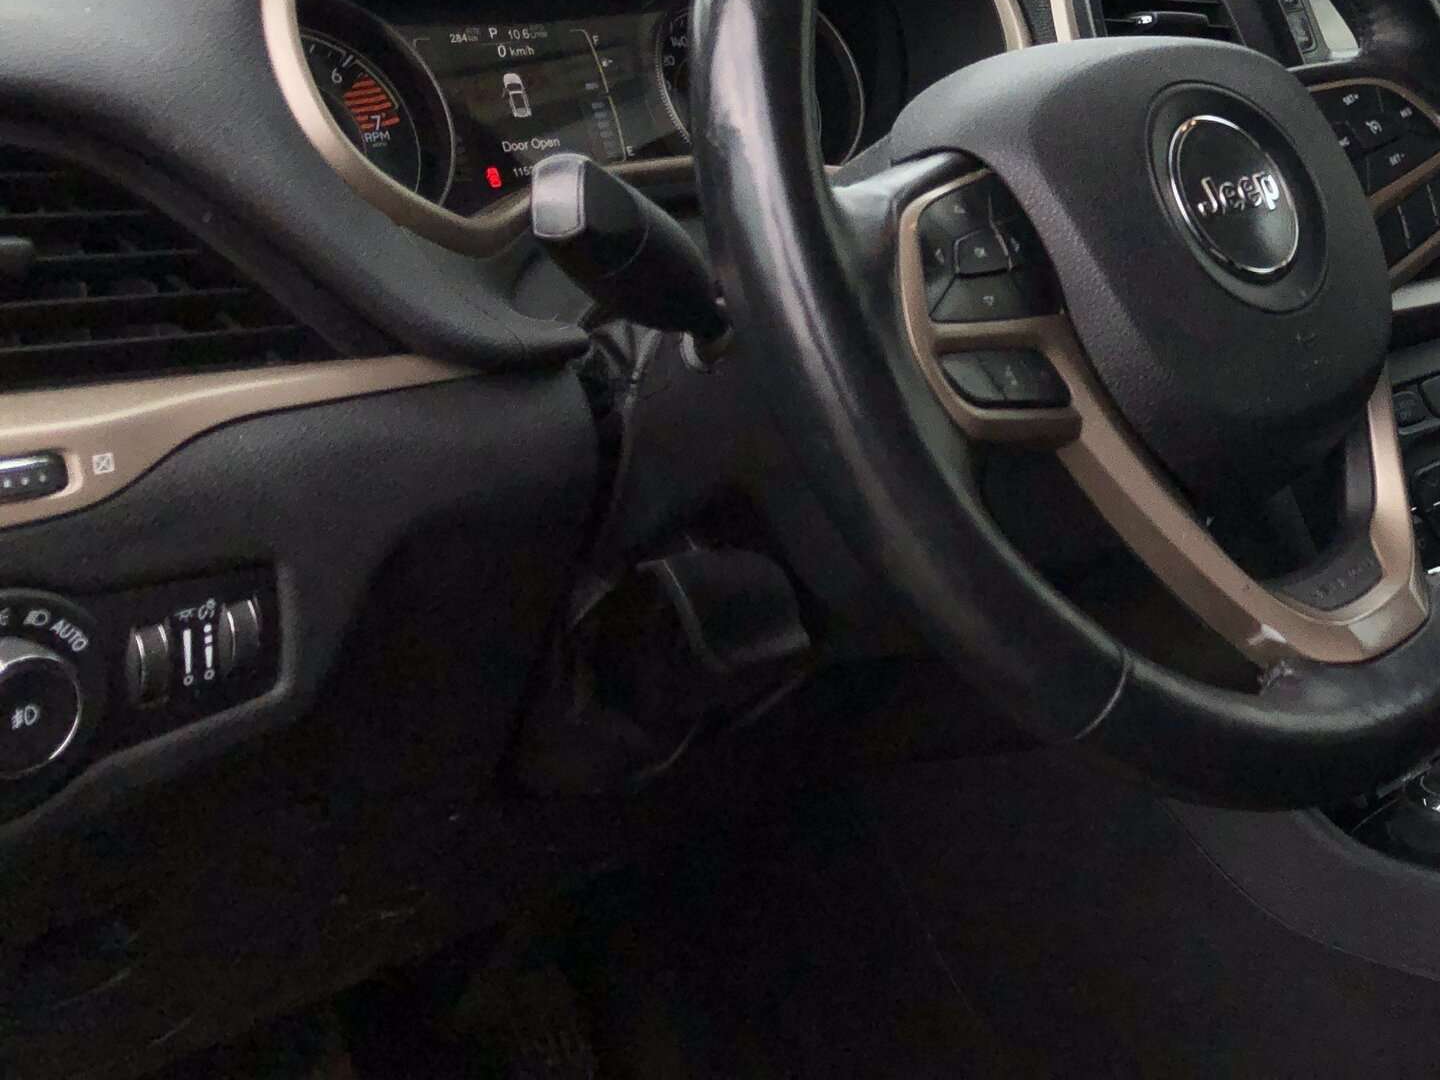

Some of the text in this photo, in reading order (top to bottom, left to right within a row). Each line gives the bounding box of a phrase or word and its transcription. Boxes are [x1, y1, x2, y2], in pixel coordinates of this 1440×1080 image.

[488, 27, 498, 39] P
[497, 44, 535, 58] 0 km/h
[331, 67, 343, 84] 6
[370, 114, 381, 131] 7
[364, 130, 391, 143] RPM
[502, 137, 561, 152] Door Open
[1197, 173, 1280, 214] Jeep
[49, 618, 88, 652] AUTO
